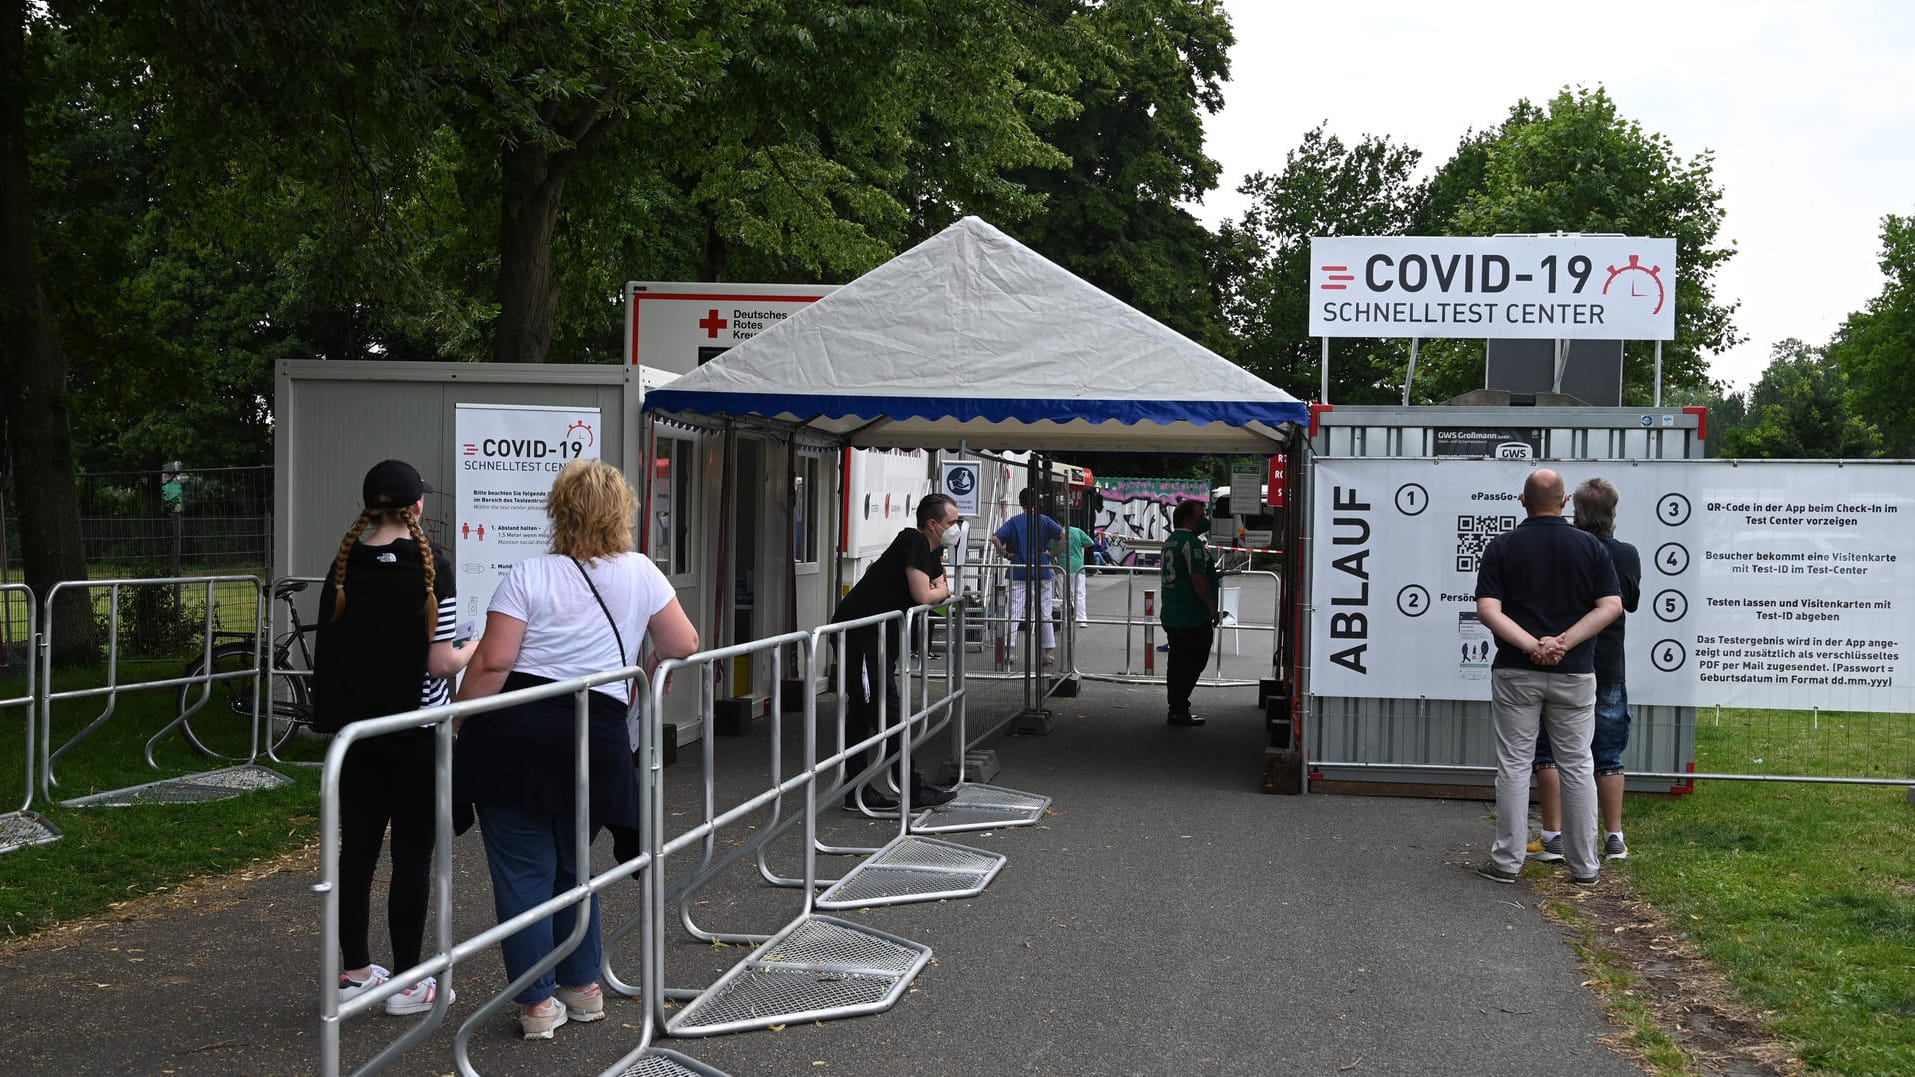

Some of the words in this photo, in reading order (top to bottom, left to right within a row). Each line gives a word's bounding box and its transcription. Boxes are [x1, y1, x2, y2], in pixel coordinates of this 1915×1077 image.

[1365, 253, 1593, 294] COVID-19
[733, 309, 788, 320] Deutsches
[1323, 302, 1498, 323] SCHNELLTEST
[1506, 303, 1605, 324] CENTER
[733, 320, 763, 330] Rotes
[733, 330, 758, 339] Kreu
[1438, 431, 1457, 439] GWS
[1458, 431, 1497, 439] Großmann
[483, 439, 583, 459] COVID-19
[1502, 449, 1527, 458] GWS
[464, 460, 542, 472] SCHNELLTEST
[545, 462, 569, 472] CEN
[1406, 490, 1415, 505] 1
[1668, 502, 1679, 517] 3
[1707, 502, 1751, 513] QR-Code
[1753, 503, 1762, 512] in
[1765, 503, 1783, 513] der
[1785, 504, 1806, 514] App
[1808, 504, 1834, 513] beim
[1836, 504, 1882, 514] Check-In
[1884, 504, 1898, 514] im
[1746, 515, 1767, 525] Test
[1769, 516, 1804, 525] Center
[1806, 517, 1858, 527] vorzeigen
[1666, 551, 1678, 566] 4
[1705, 551, 1754, 561] Besucher
[1756, 551, 1805, 561] bekommt
[1807, 553, 1830, 561] eine
[1832, 553, 1897, 563] Visitenkarte
[1732, 564, 1749, 573] mit
[1751, 564, 1789, 574] Test-ID
[1791, 565, 1804, 574] im
[1807, 565, 1868, 575] Test-Center
[1329, 486, 1371, 675] ABLAUF
[1408, 593, 1419, 608] 2
[1440, 593, 1475, 602] Persön
[1665, 598, 1676, 613] 5
[1706, 597, 1741, 607] Testen
[1743, 598, 1777, 608] lassen
[1779, 598, 1798, 608] und
[1801, 599, 1871, 609] Visitenkarten
[1874, 600, 1892, 609] mit
[1756, 611, 1793, 621] Test-ID
[1795, 611, 1840, 622] abgeben
[1697, 635, 1715, 644] Das
[1718, 635, 1785, 646] Testergebnis
[1787, 636, 1810, 646] wird
[1812, 637, 1822, 646] in
[1825, 637, 1843, 647] der
[1845, 638, 1866, 648] App
[1868, 639, 1898, 648] ange-
[1663, 648, 1674, 663] 6
[1695, 648, 1720, 658] zeigt
[1722, 648, 1742, 658] und
[1744, 649, 1796, 659] zusätzlich
[1798, 650, 1814, 659] als
[1816, 650, 1899, 661] verschlüsseltes
[1699, 660, 1720, 670] PDF
[1722, 662, 1740, 672] per
[1742, 661, 1764, 670] Mail
[1766, 662, 1830, 673] zugesendet.
[1832, 663, 1885, 674] (Passwort
[1699, 673, 1773, 684] Geburtsdatum
[1775, 675, 1789, 683] im
[1791, 675, 1828, 684] Format
[1831, 676, 1892, 687] dd.mm.yyy)
